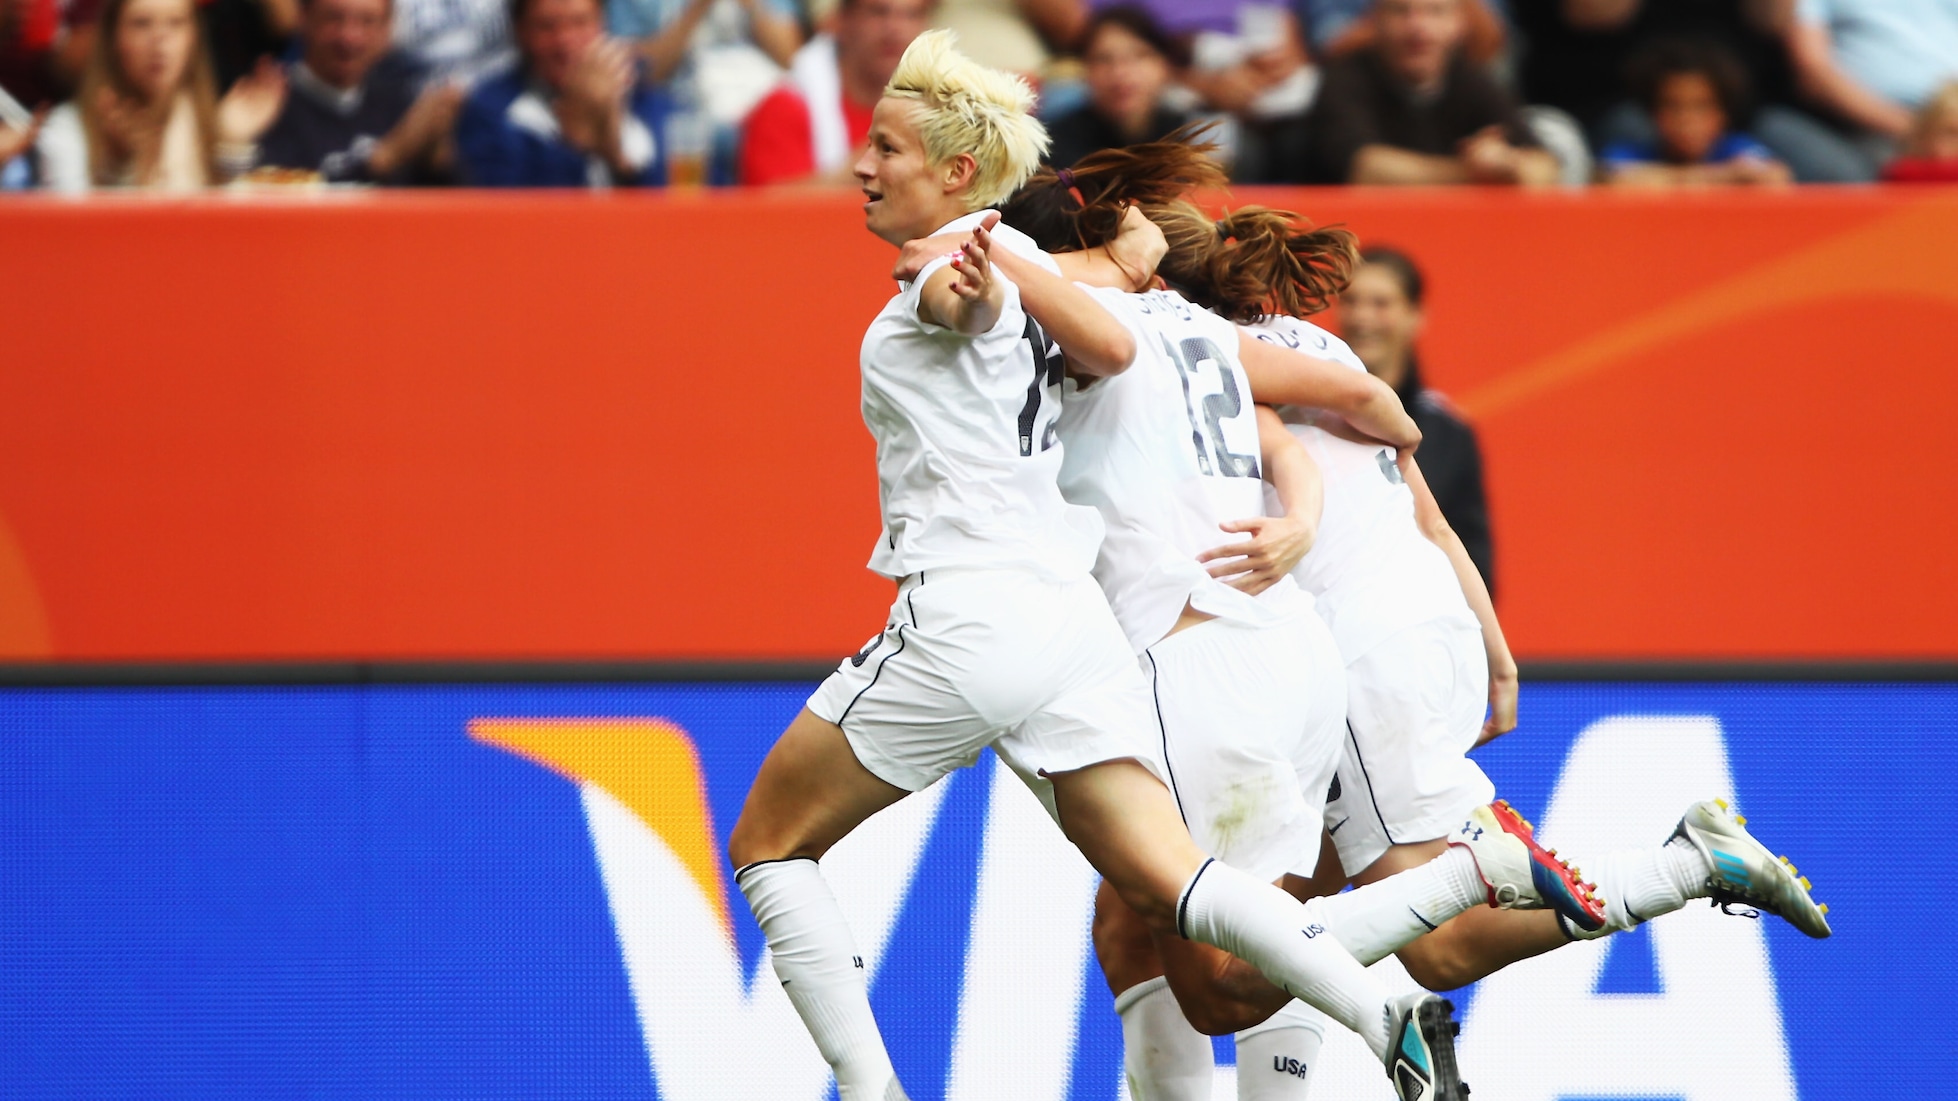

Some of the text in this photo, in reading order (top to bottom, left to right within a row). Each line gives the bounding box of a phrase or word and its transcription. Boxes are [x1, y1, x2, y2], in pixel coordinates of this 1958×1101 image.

[1159, 331, 1261, 479] 12
[467, 716, 1799, 1101] VIA
[1273, 1055, 1307, 1080] USA
